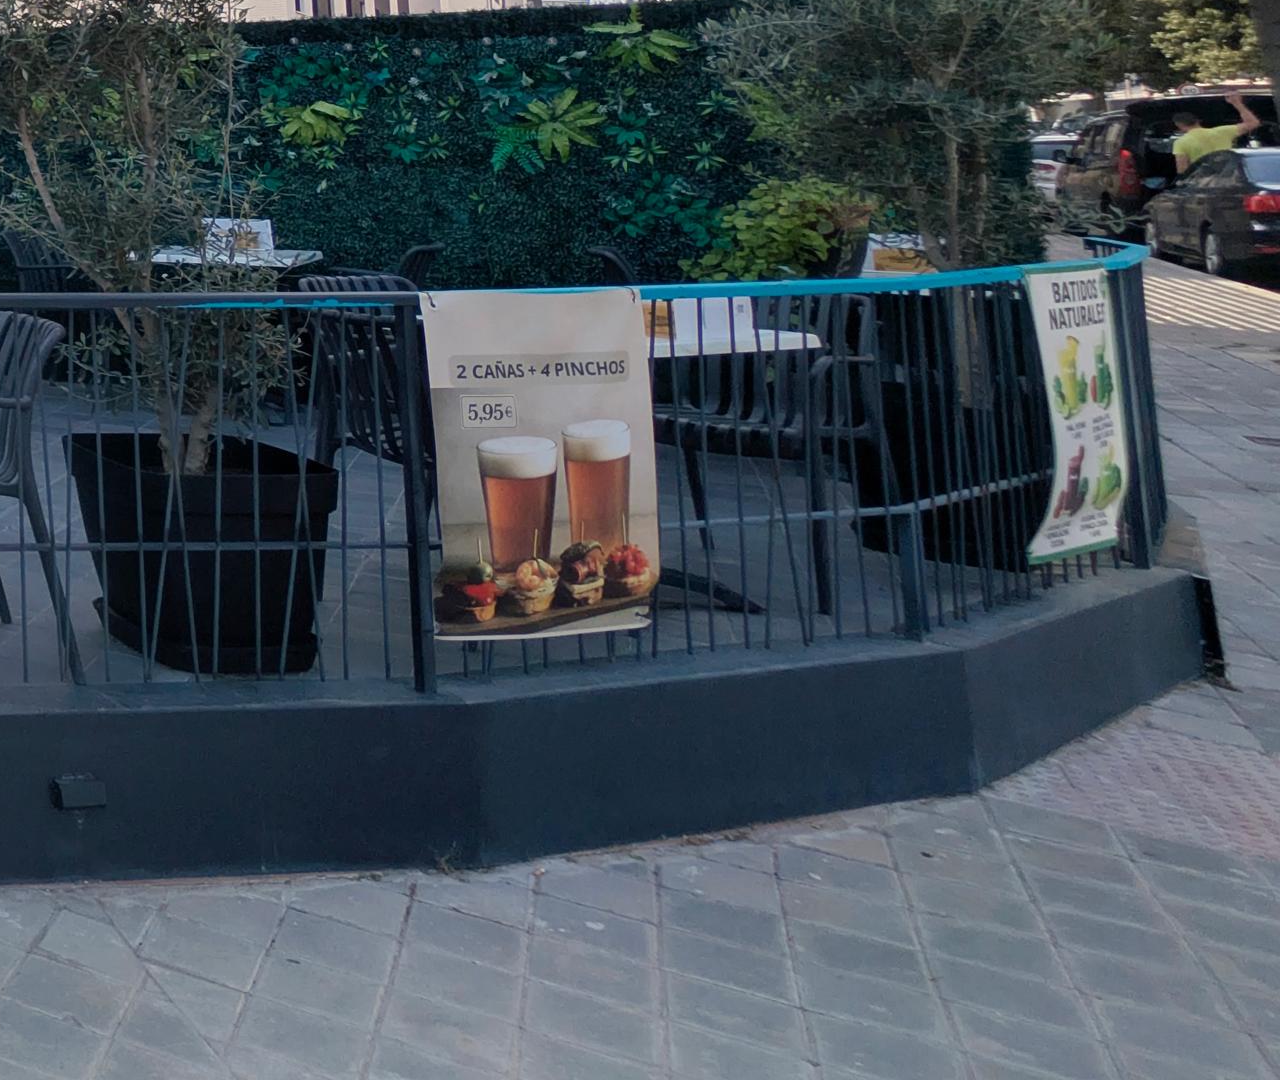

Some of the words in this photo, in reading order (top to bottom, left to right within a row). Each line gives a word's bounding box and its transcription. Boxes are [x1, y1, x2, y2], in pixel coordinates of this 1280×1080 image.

[1051, 278, 1098, 303] BATIDOS
[456, 364, 468, 379] 2
[472, 360, 525, 379] CAÑAS
[528, 366, 537, 376] +
[541, 363, 551, 377] 4
[555, 360, 625, 377] PINCHOS
[468, 403, 513, 424] 5,95€
